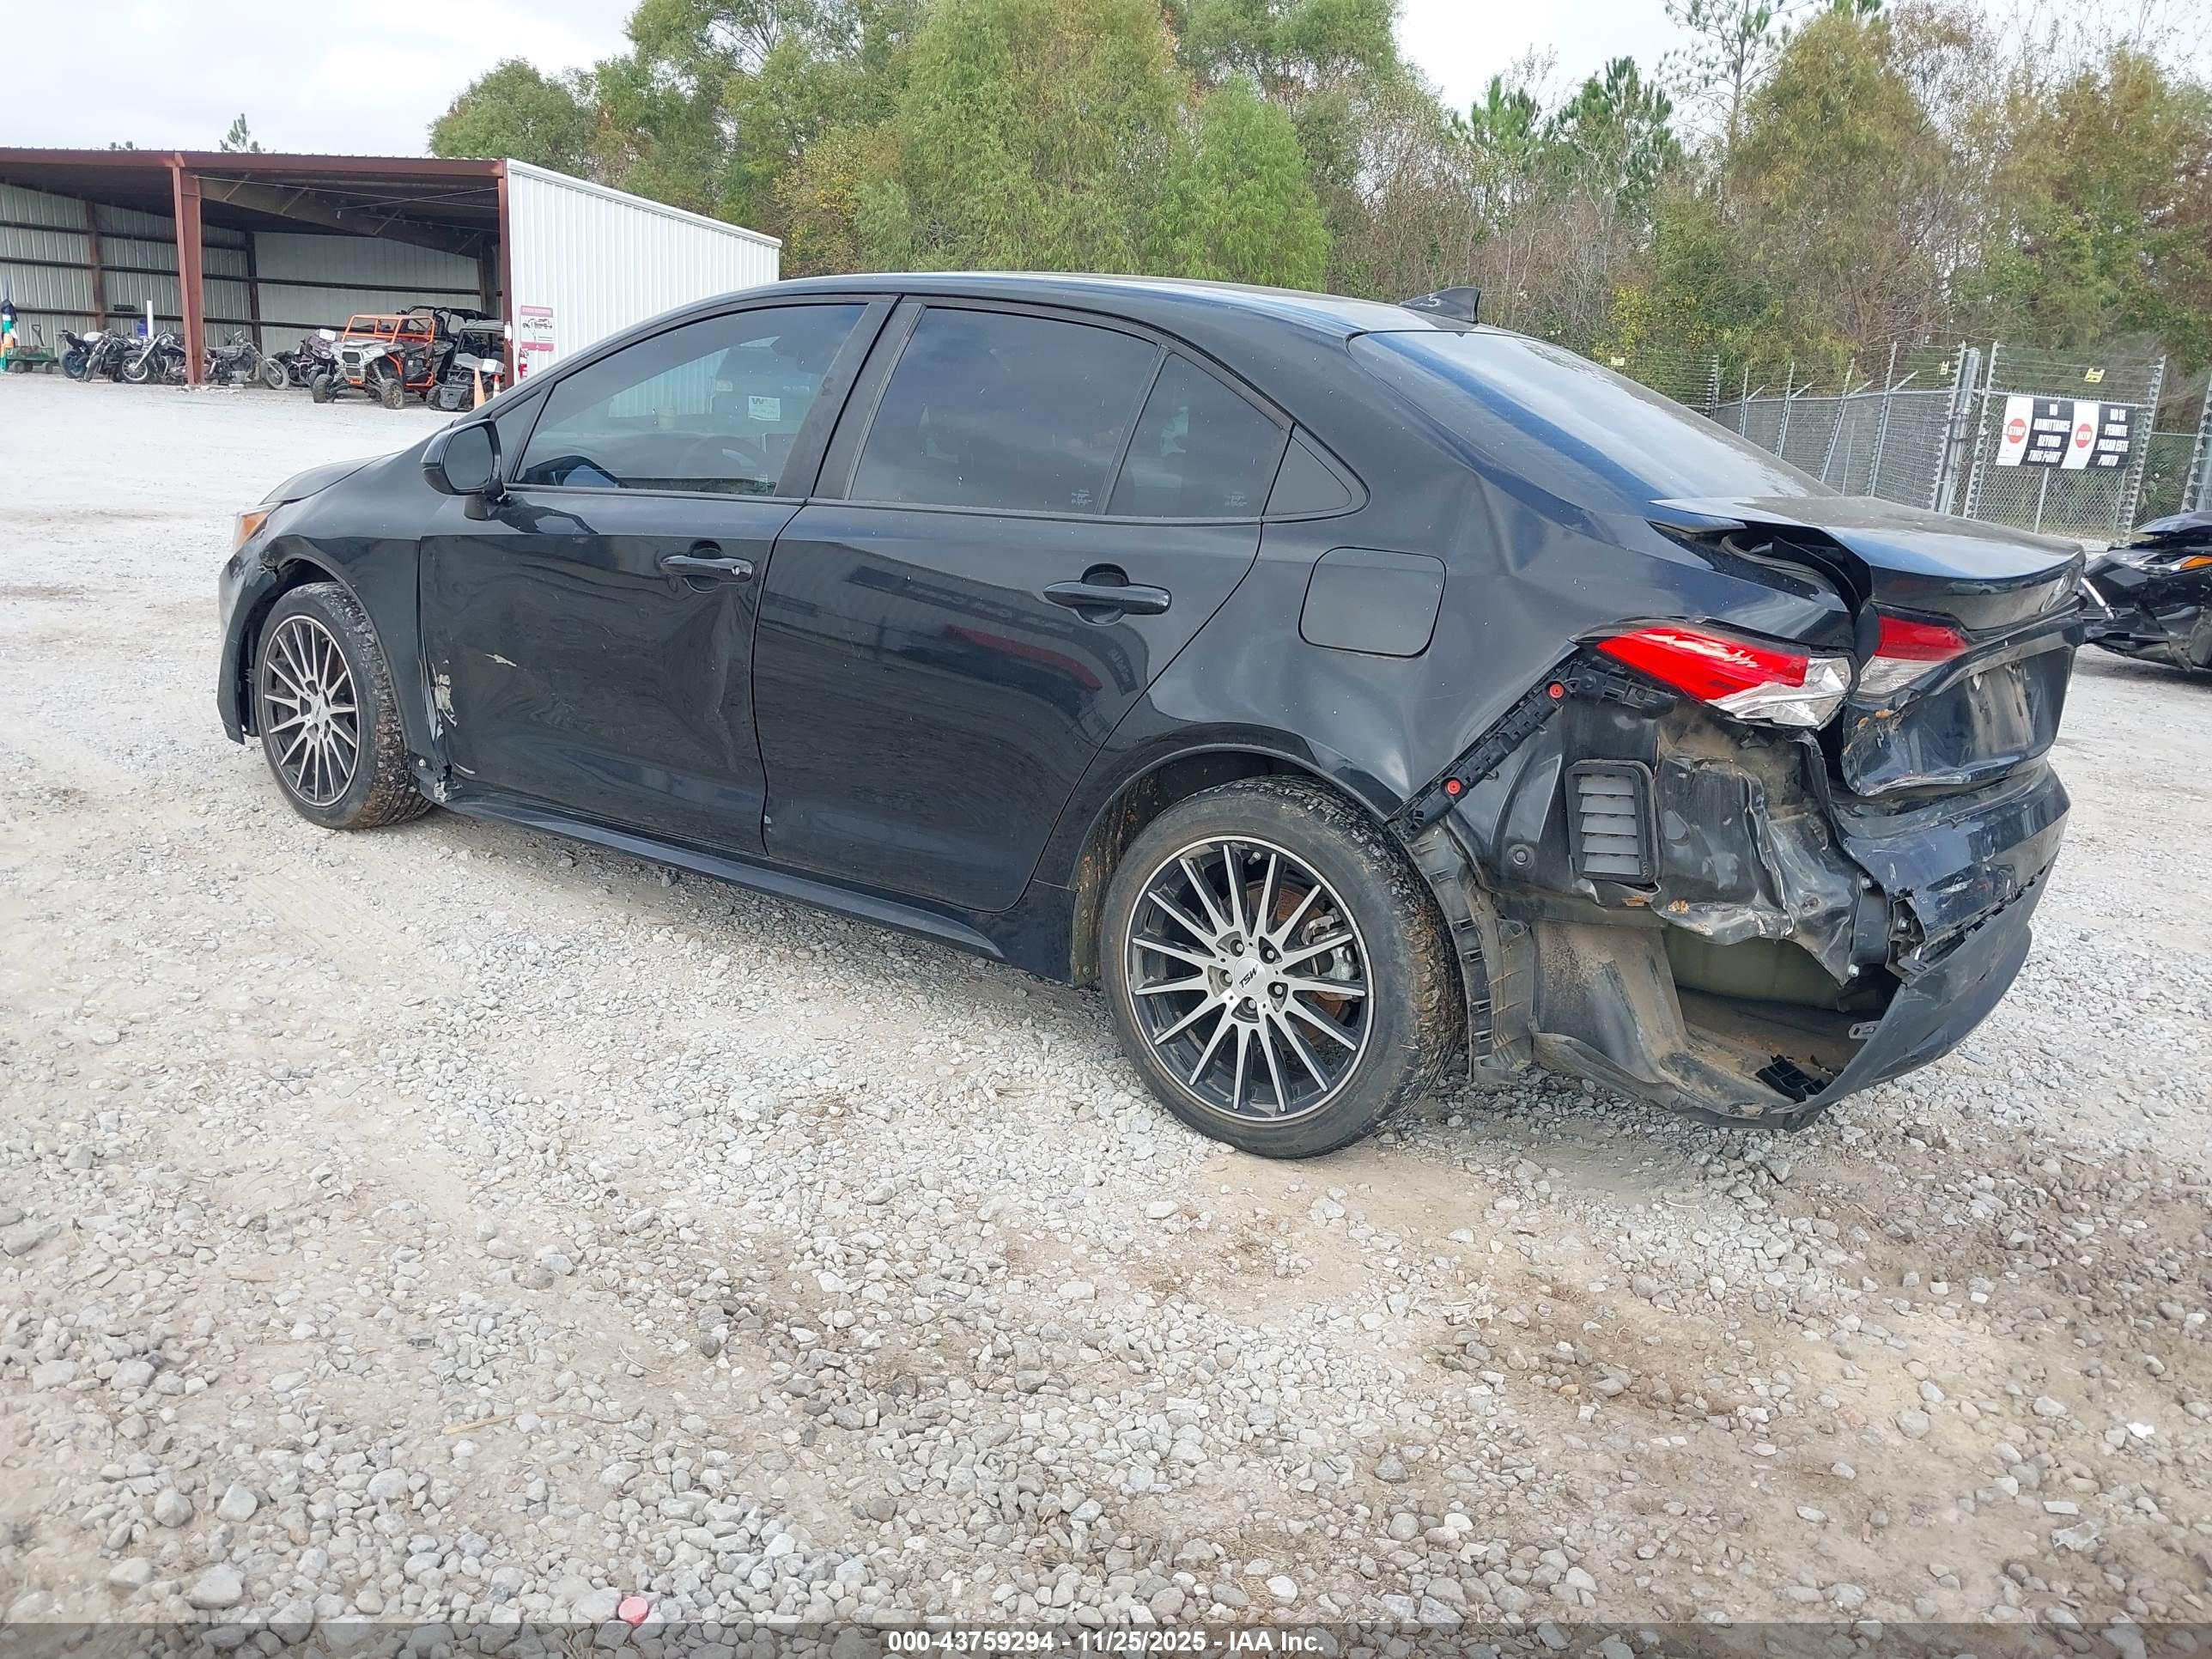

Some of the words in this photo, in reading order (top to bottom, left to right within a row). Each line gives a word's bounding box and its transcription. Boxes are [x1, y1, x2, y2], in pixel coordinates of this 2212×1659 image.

[2049, 404, 2058, 416] NO
[2110, 408, 2118, 421] NO
[2118, 410, 2126, 422] SE
[2008, 426, 2026, 436] STOP
[2033, 418, 2071, 433] ADMITTANCE
[2104, 423, 2128, 437] PERMITE
[2036, 434, 2061, 447] BEYOND
[2096, 439, 2117, 452] PASAR
[2115, 440, 2130, 453] ESTE
[2027, 449, 2045, 462] THIS
[2040, 450, 2063, 463] POINT
[1238, 963, 1259, 988] TSW
